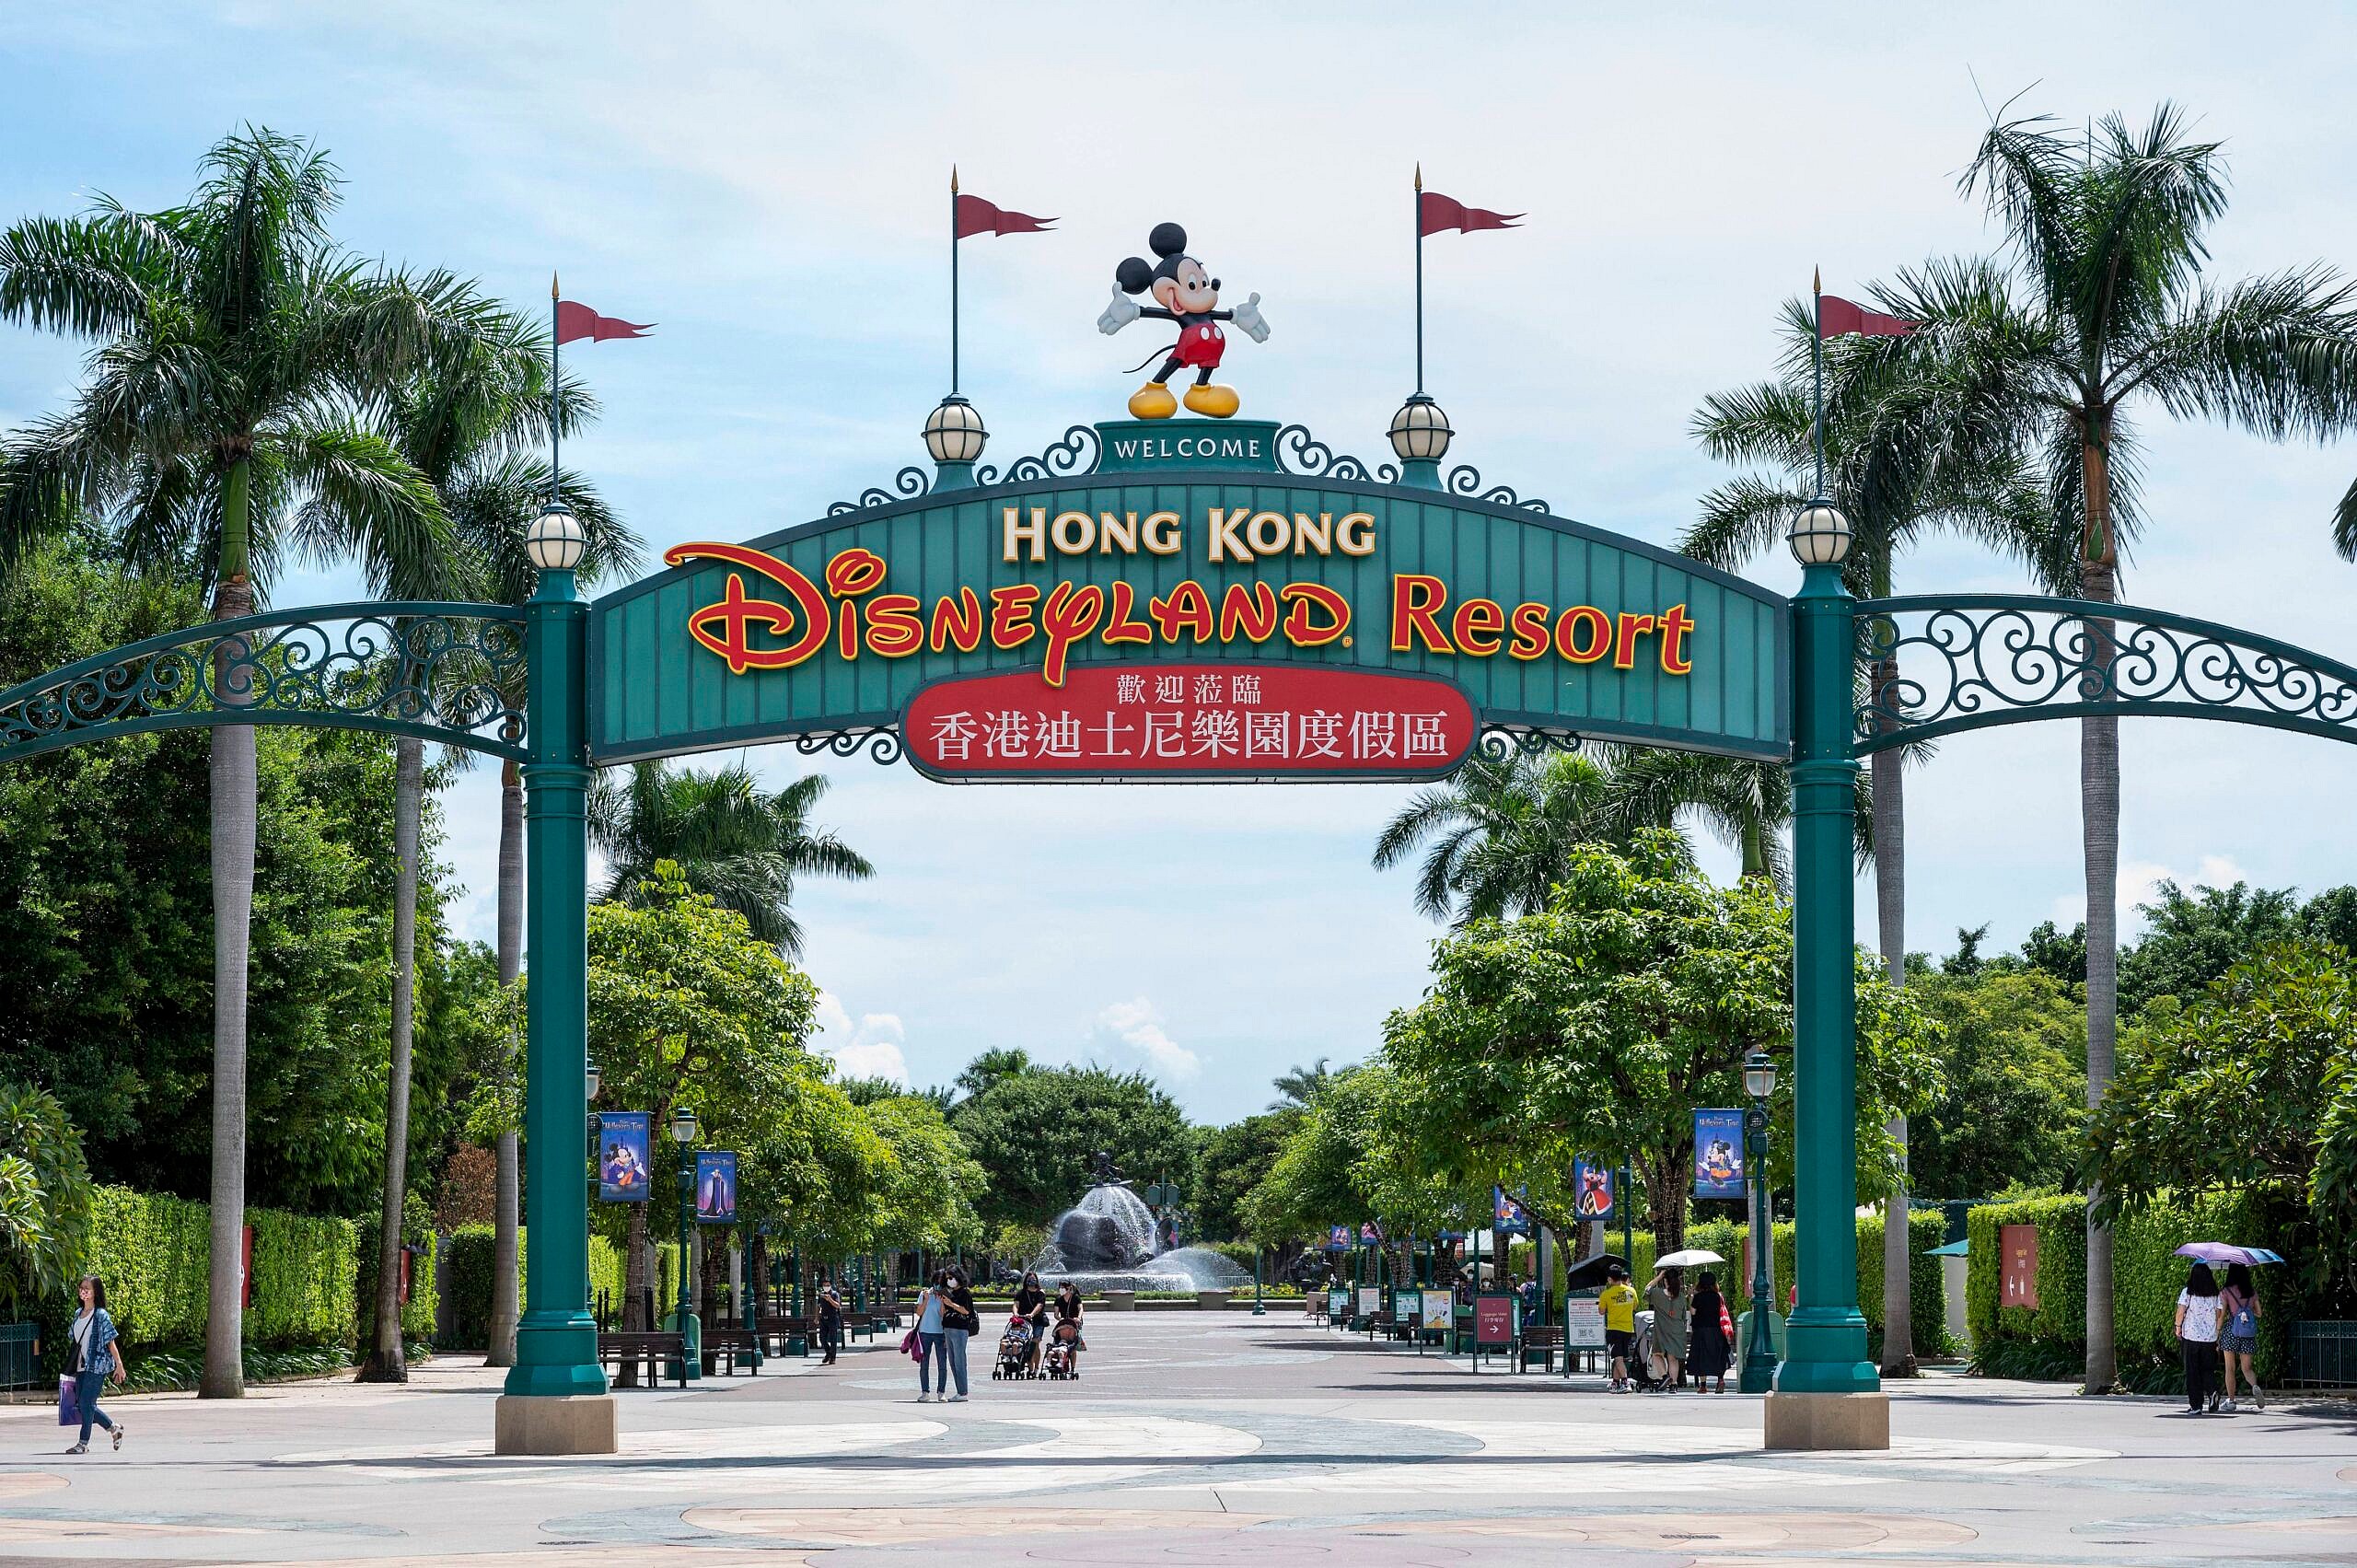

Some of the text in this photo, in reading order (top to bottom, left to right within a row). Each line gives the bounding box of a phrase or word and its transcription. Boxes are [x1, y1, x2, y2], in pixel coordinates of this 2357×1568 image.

[1114, 437, 1261, 459] WELCOME
[1003, 506, 1376, 563] HONG KONG
[1391, 574, 1695, 675] Resort
[1116, 674, 1261, 705] 歡迎蒞臨
[929, 709, 1449, 761] 香港迪士尼樂園度假區
